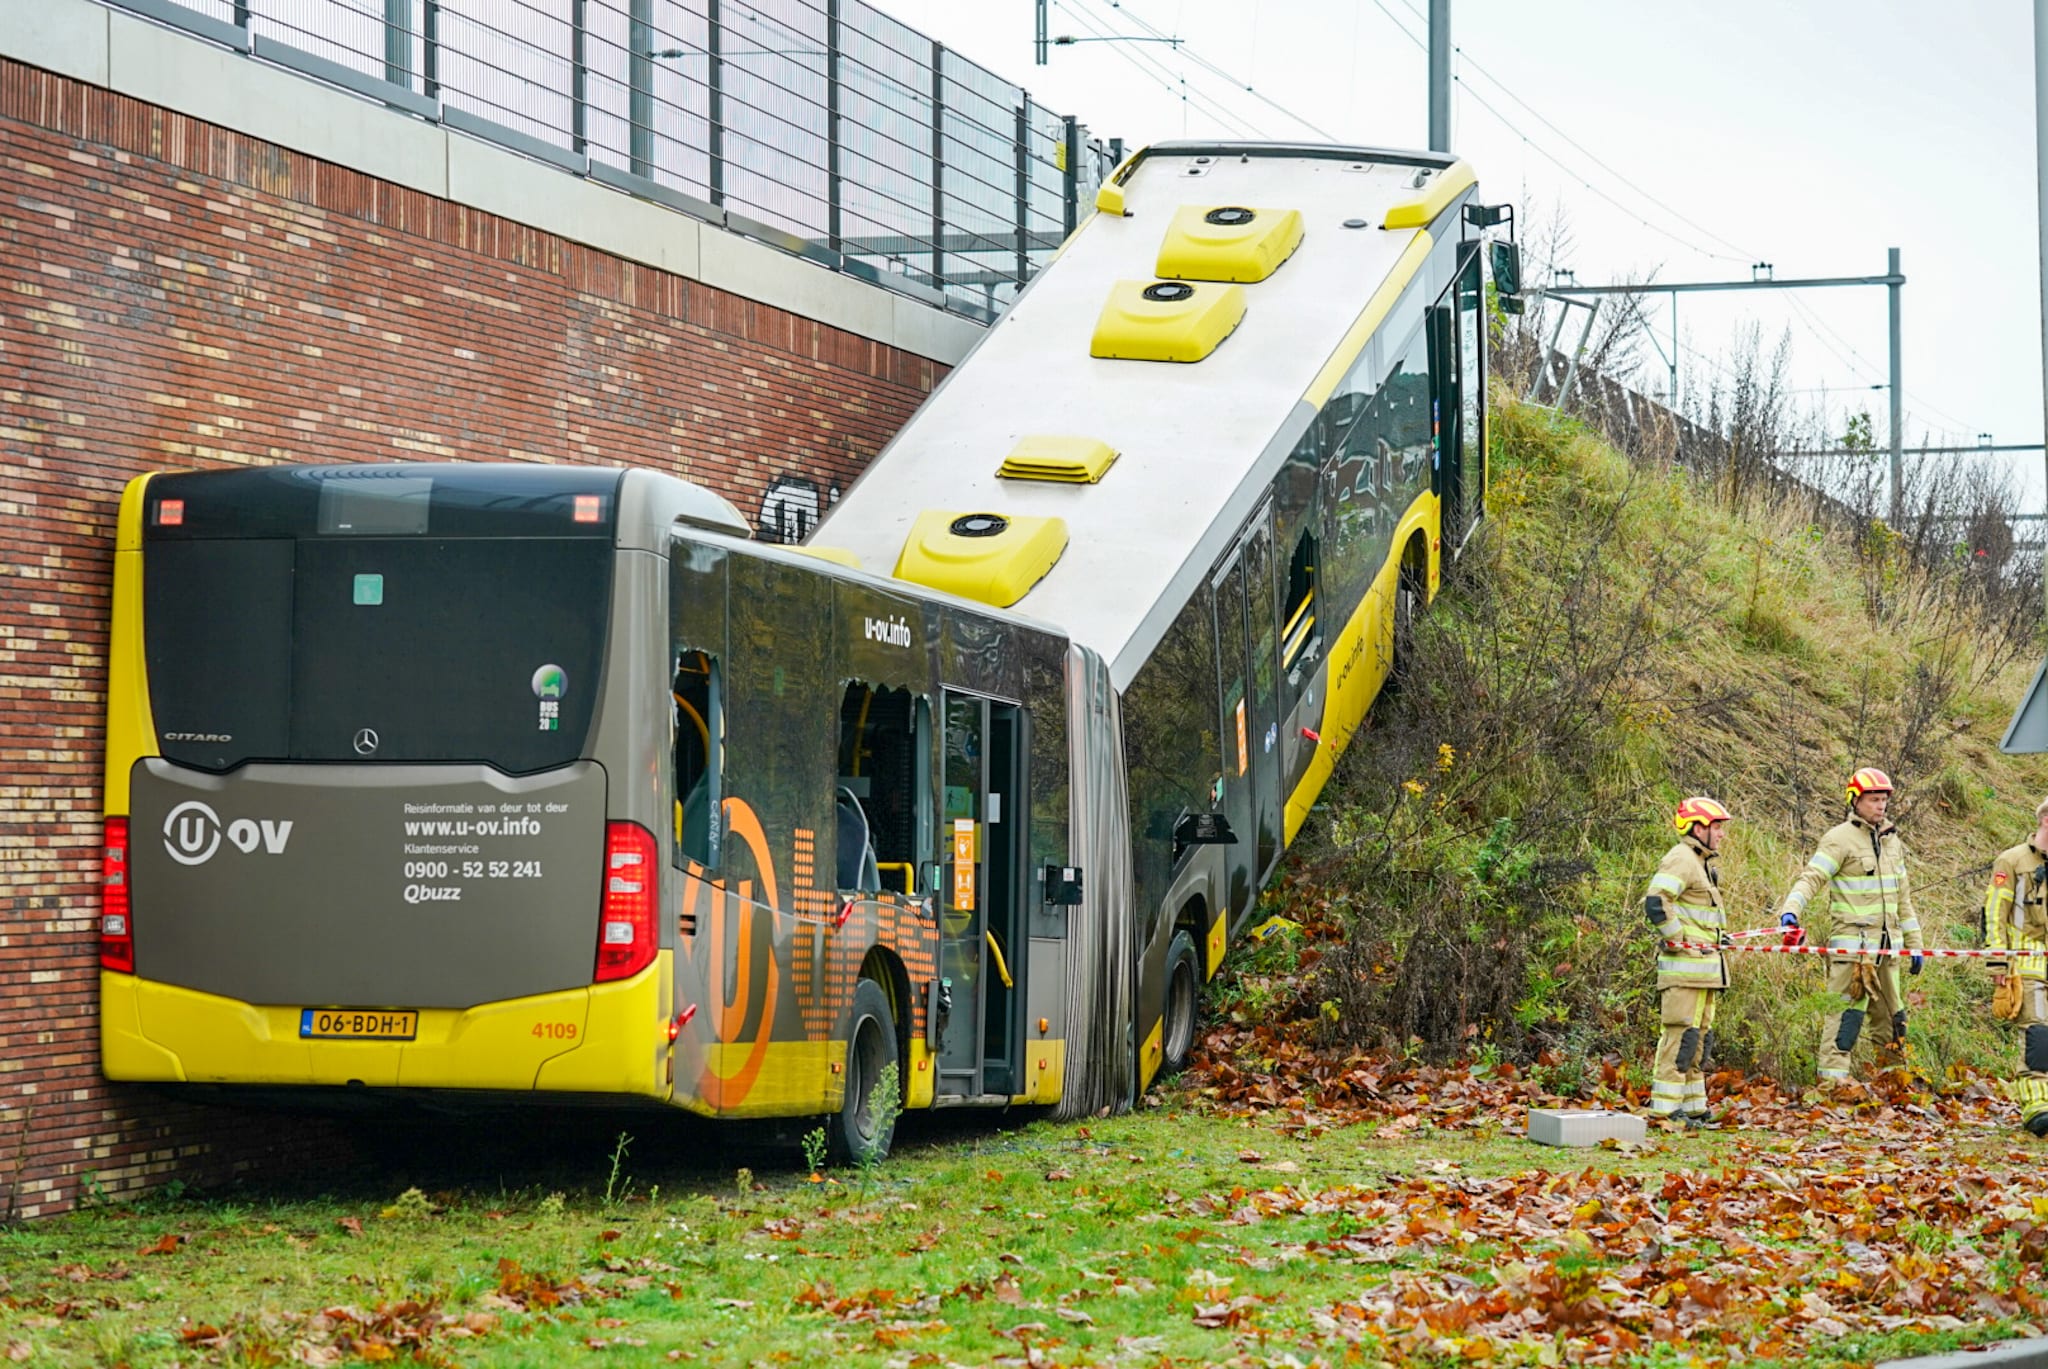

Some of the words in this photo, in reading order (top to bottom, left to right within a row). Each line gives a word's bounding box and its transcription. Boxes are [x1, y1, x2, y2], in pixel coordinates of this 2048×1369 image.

[864, 614, 911, 649] u-ov.info
[540, 701, 559, 712] BUS
[164, 732, 233, 742] CITARO
[404, 803, 474, 814] Reisinformatie
[477, 804, 496, 813] van
[500, 803, 523, 813] deur
[527, 803, 541, 813] tot
[545, 802, 569, 813] deur
[404, 816, 541, 836] www.u-ov.info
[404, 843, 480, 854] Klantenservice
[404, 861, 448, 878] 0900
[462, 861, 484, 878] 52
[488, 861, 509, 878] 52
[512, 861, 543, 878] 241
[404, 884, 462, 904] Qbuzz
[319, 1014, 408, 1034] 06-BDH-1
[531, 1022, 578, 1039] 4109
